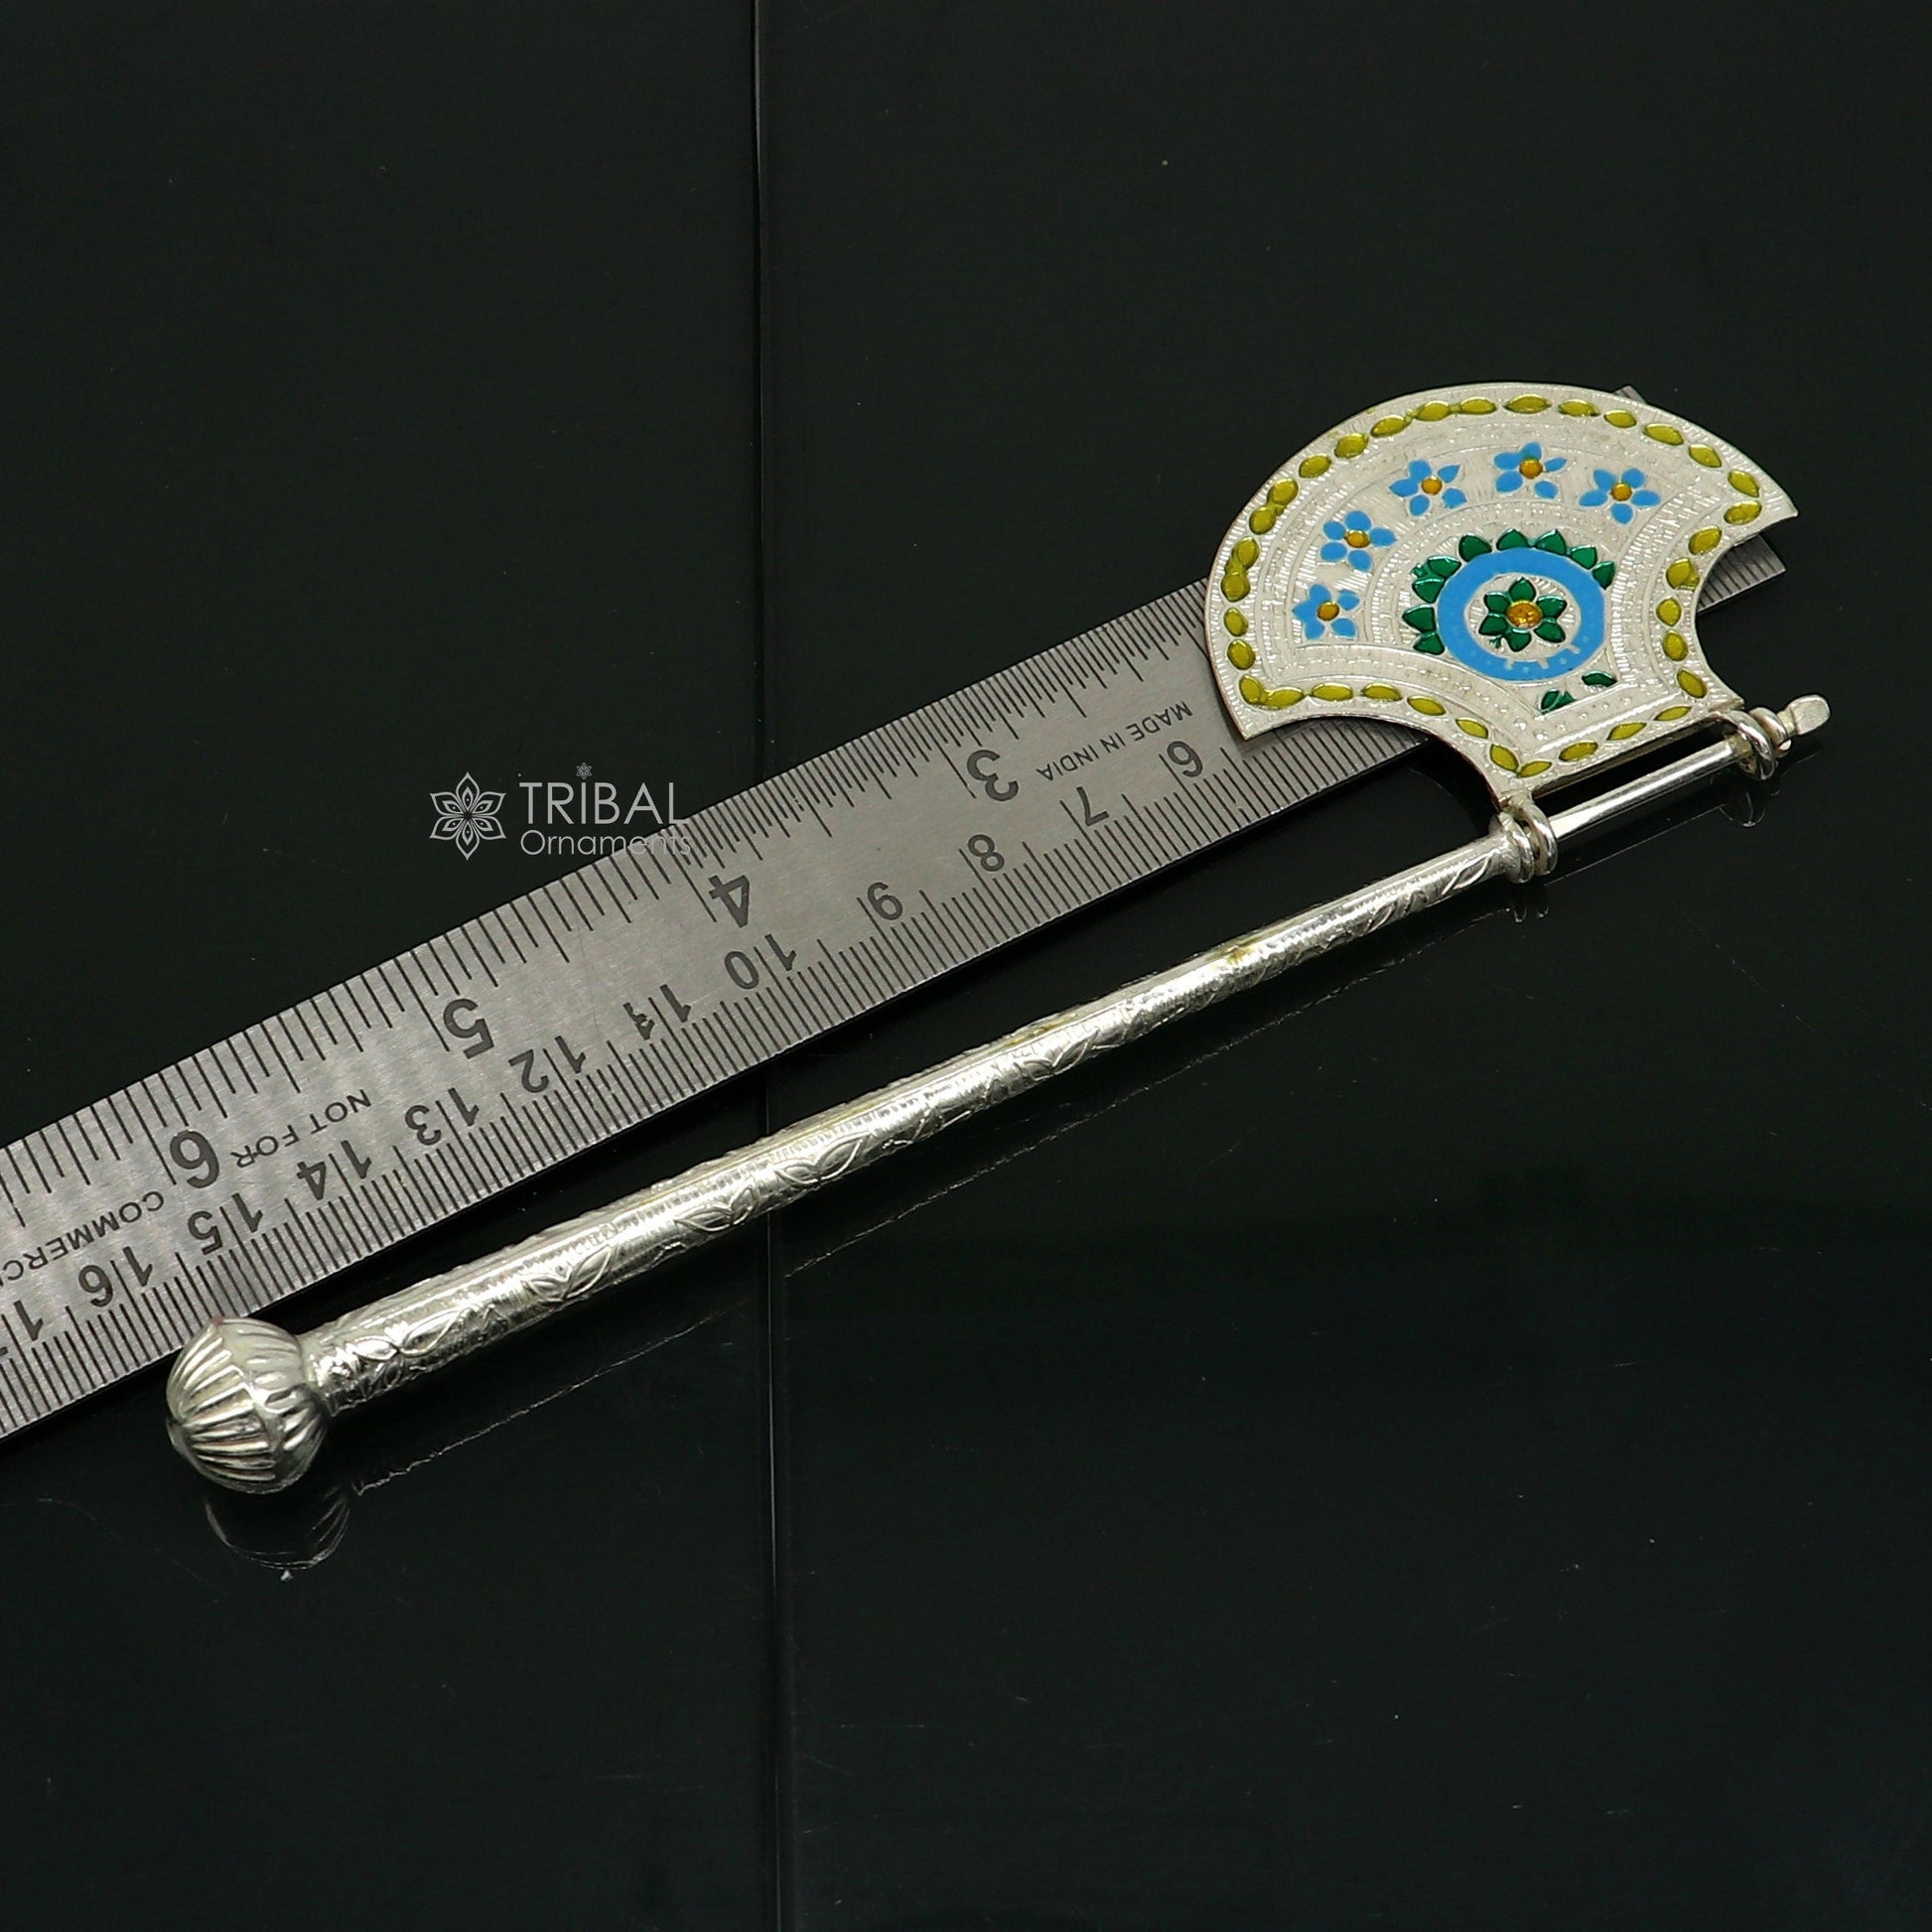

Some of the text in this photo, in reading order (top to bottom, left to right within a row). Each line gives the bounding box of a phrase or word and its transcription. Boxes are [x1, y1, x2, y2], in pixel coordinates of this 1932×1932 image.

[1036, 701, 1194, 781] MADE IN INDIA
[1166, 740, 1204, 778] 6
[966, 749, 1021, 802] 3
[1075, 785, 1110, 827] 7
[967, 833, 1006, 873] 8
[708, 875, 751, 927] 4
[866, 881, 904, 921] 9
[724, 933, 797, 991] 10
[442, 999, 495, 1059] 5
[508, 1035, 587, 1093] 12
[404, 1087, 481, 1146] 13
[169, 1130, 219, 1188] 6
[297, 1140, 372, 1200] 14
[0, 1090, 372, 1287] NOT FOR COMMERC
[187, 1192, 264, 1255] 15
[77, 1246, 154, 1308] 16
